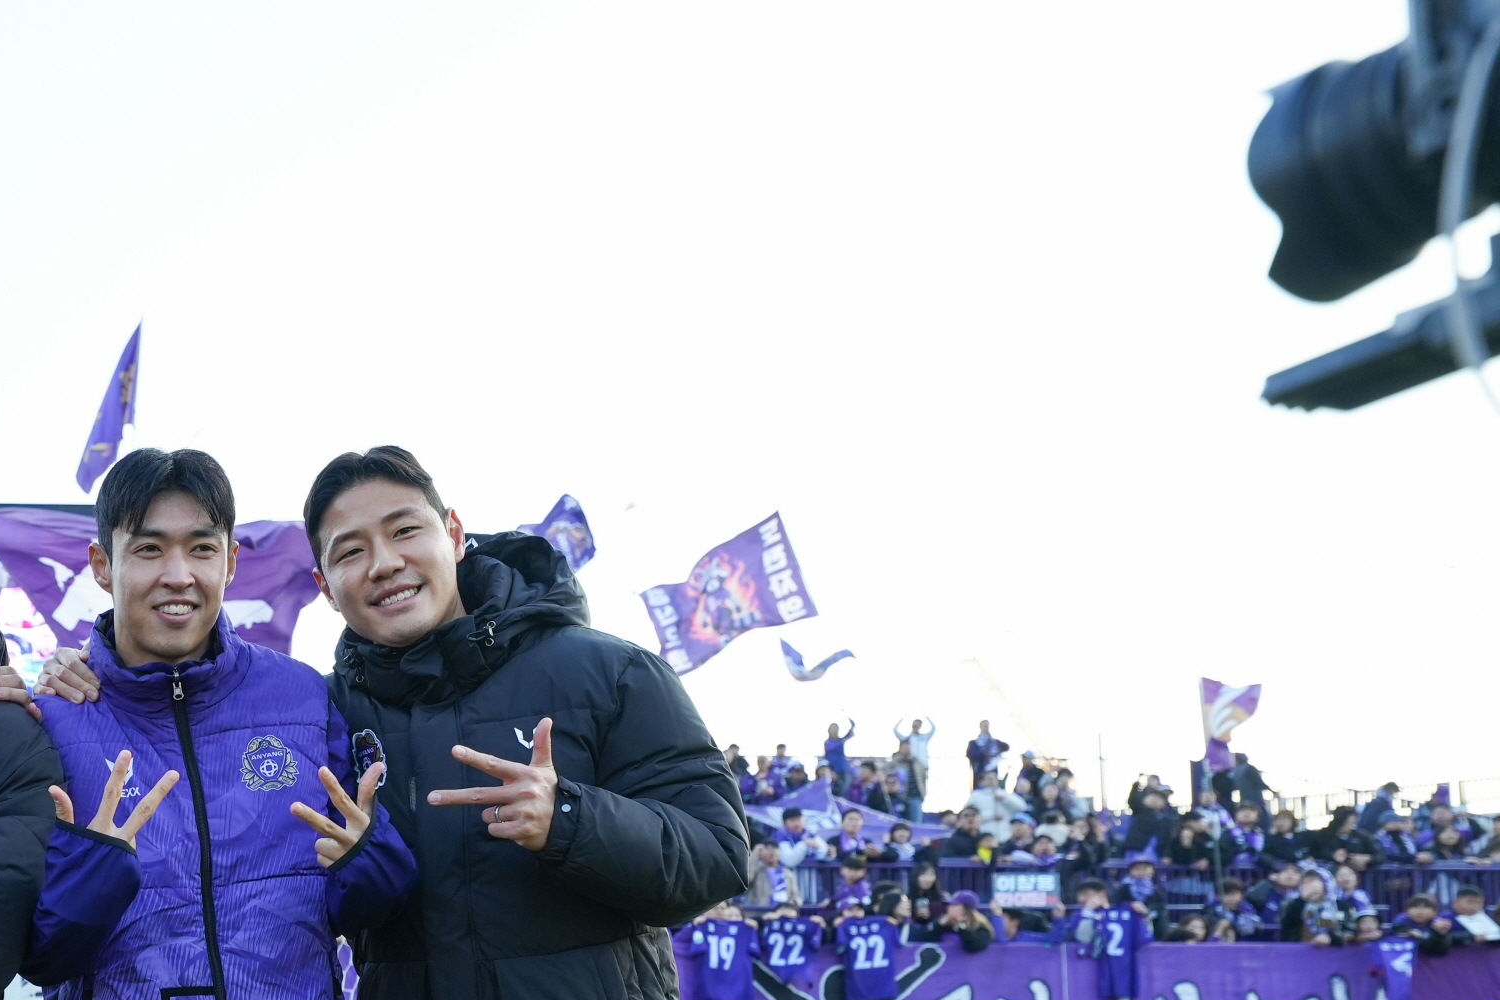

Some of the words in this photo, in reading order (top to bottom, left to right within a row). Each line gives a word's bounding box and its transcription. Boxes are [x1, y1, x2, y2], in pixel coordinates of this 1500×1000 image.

[250, 750, 284, 761] ANYANG
[120, 786, 142, 798] EXX
[707, 934, 737, 971] 19
[767, 932, 806, 967] 22
[850, 934, 890, 971] 22
[1106, 922, 1125, 957] 2
